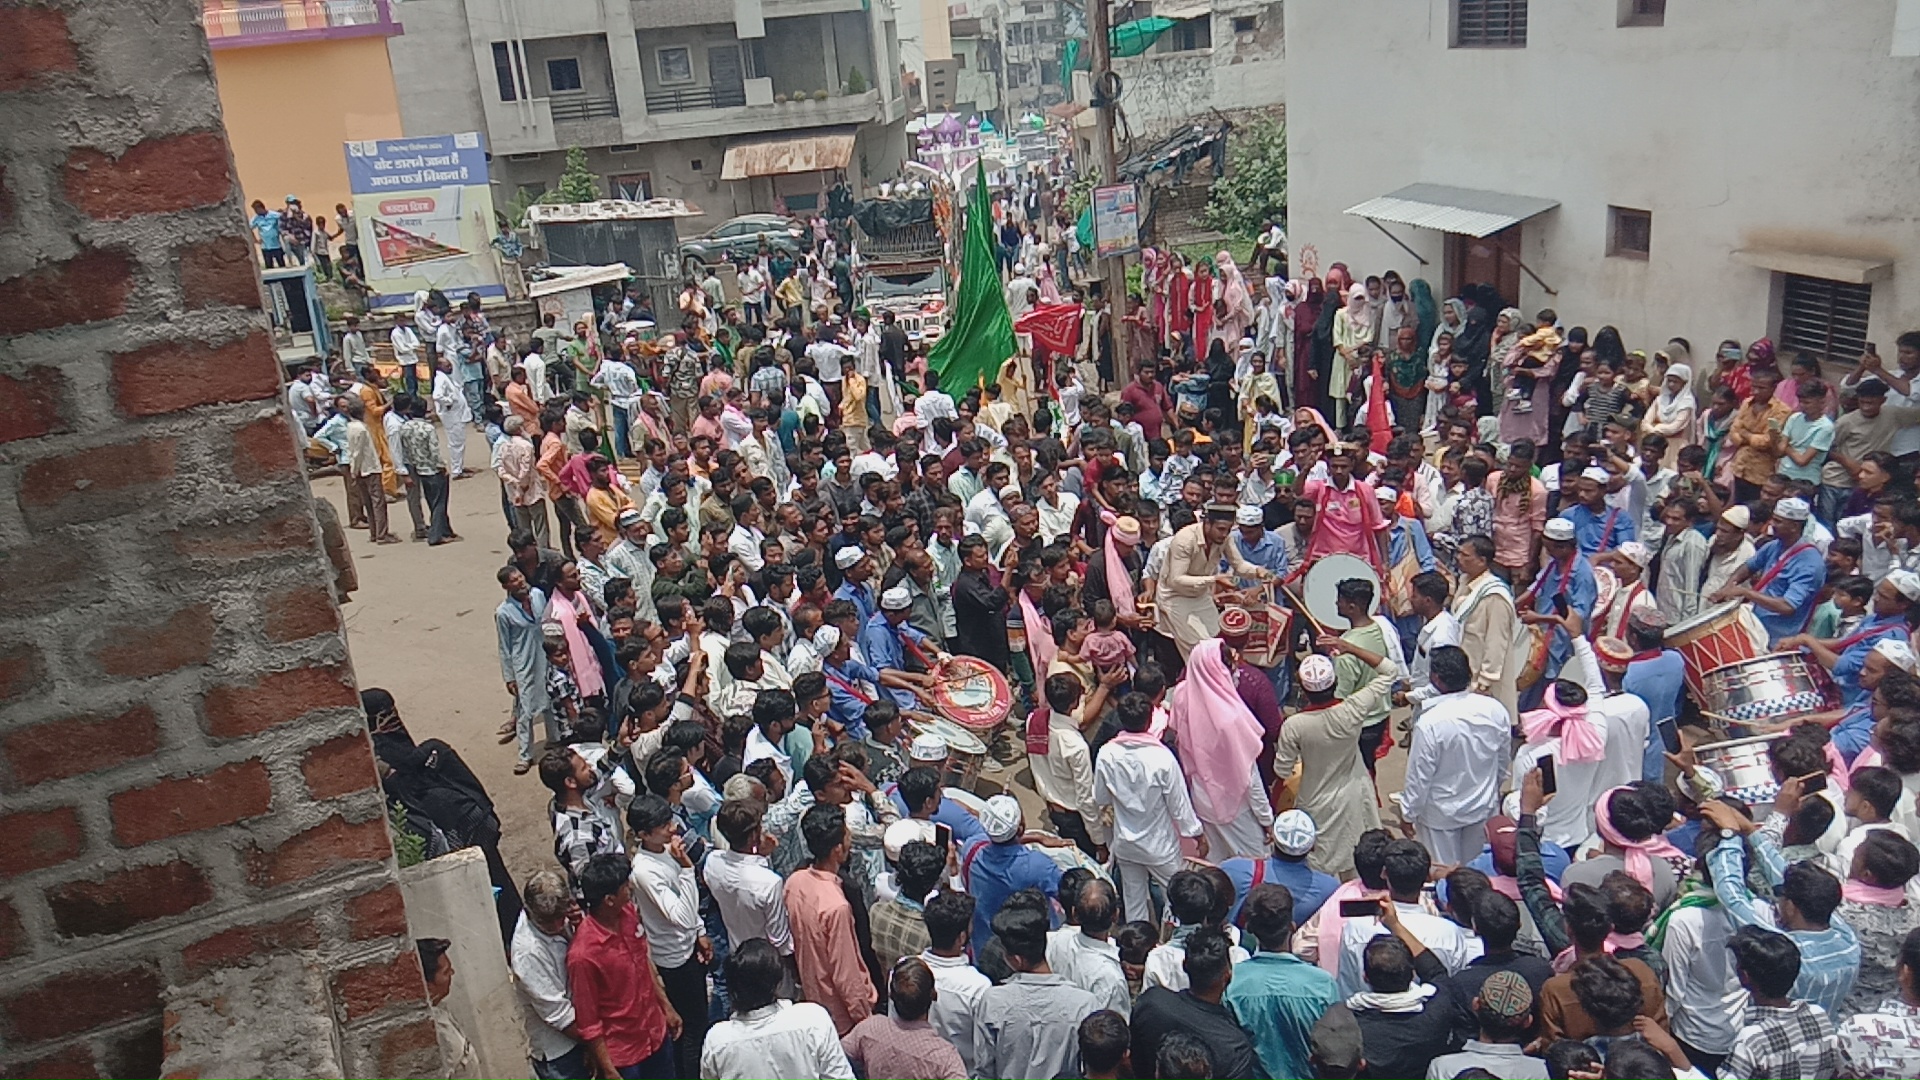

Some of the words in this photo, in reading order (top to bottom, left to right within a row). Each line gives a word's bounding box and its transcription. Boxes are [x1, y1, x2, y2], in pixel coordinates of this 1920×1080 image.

[373, 156, 393, 170] वोट
[424, 155, 450, 167] जाना
[370, 175, 400, 187] अपना
